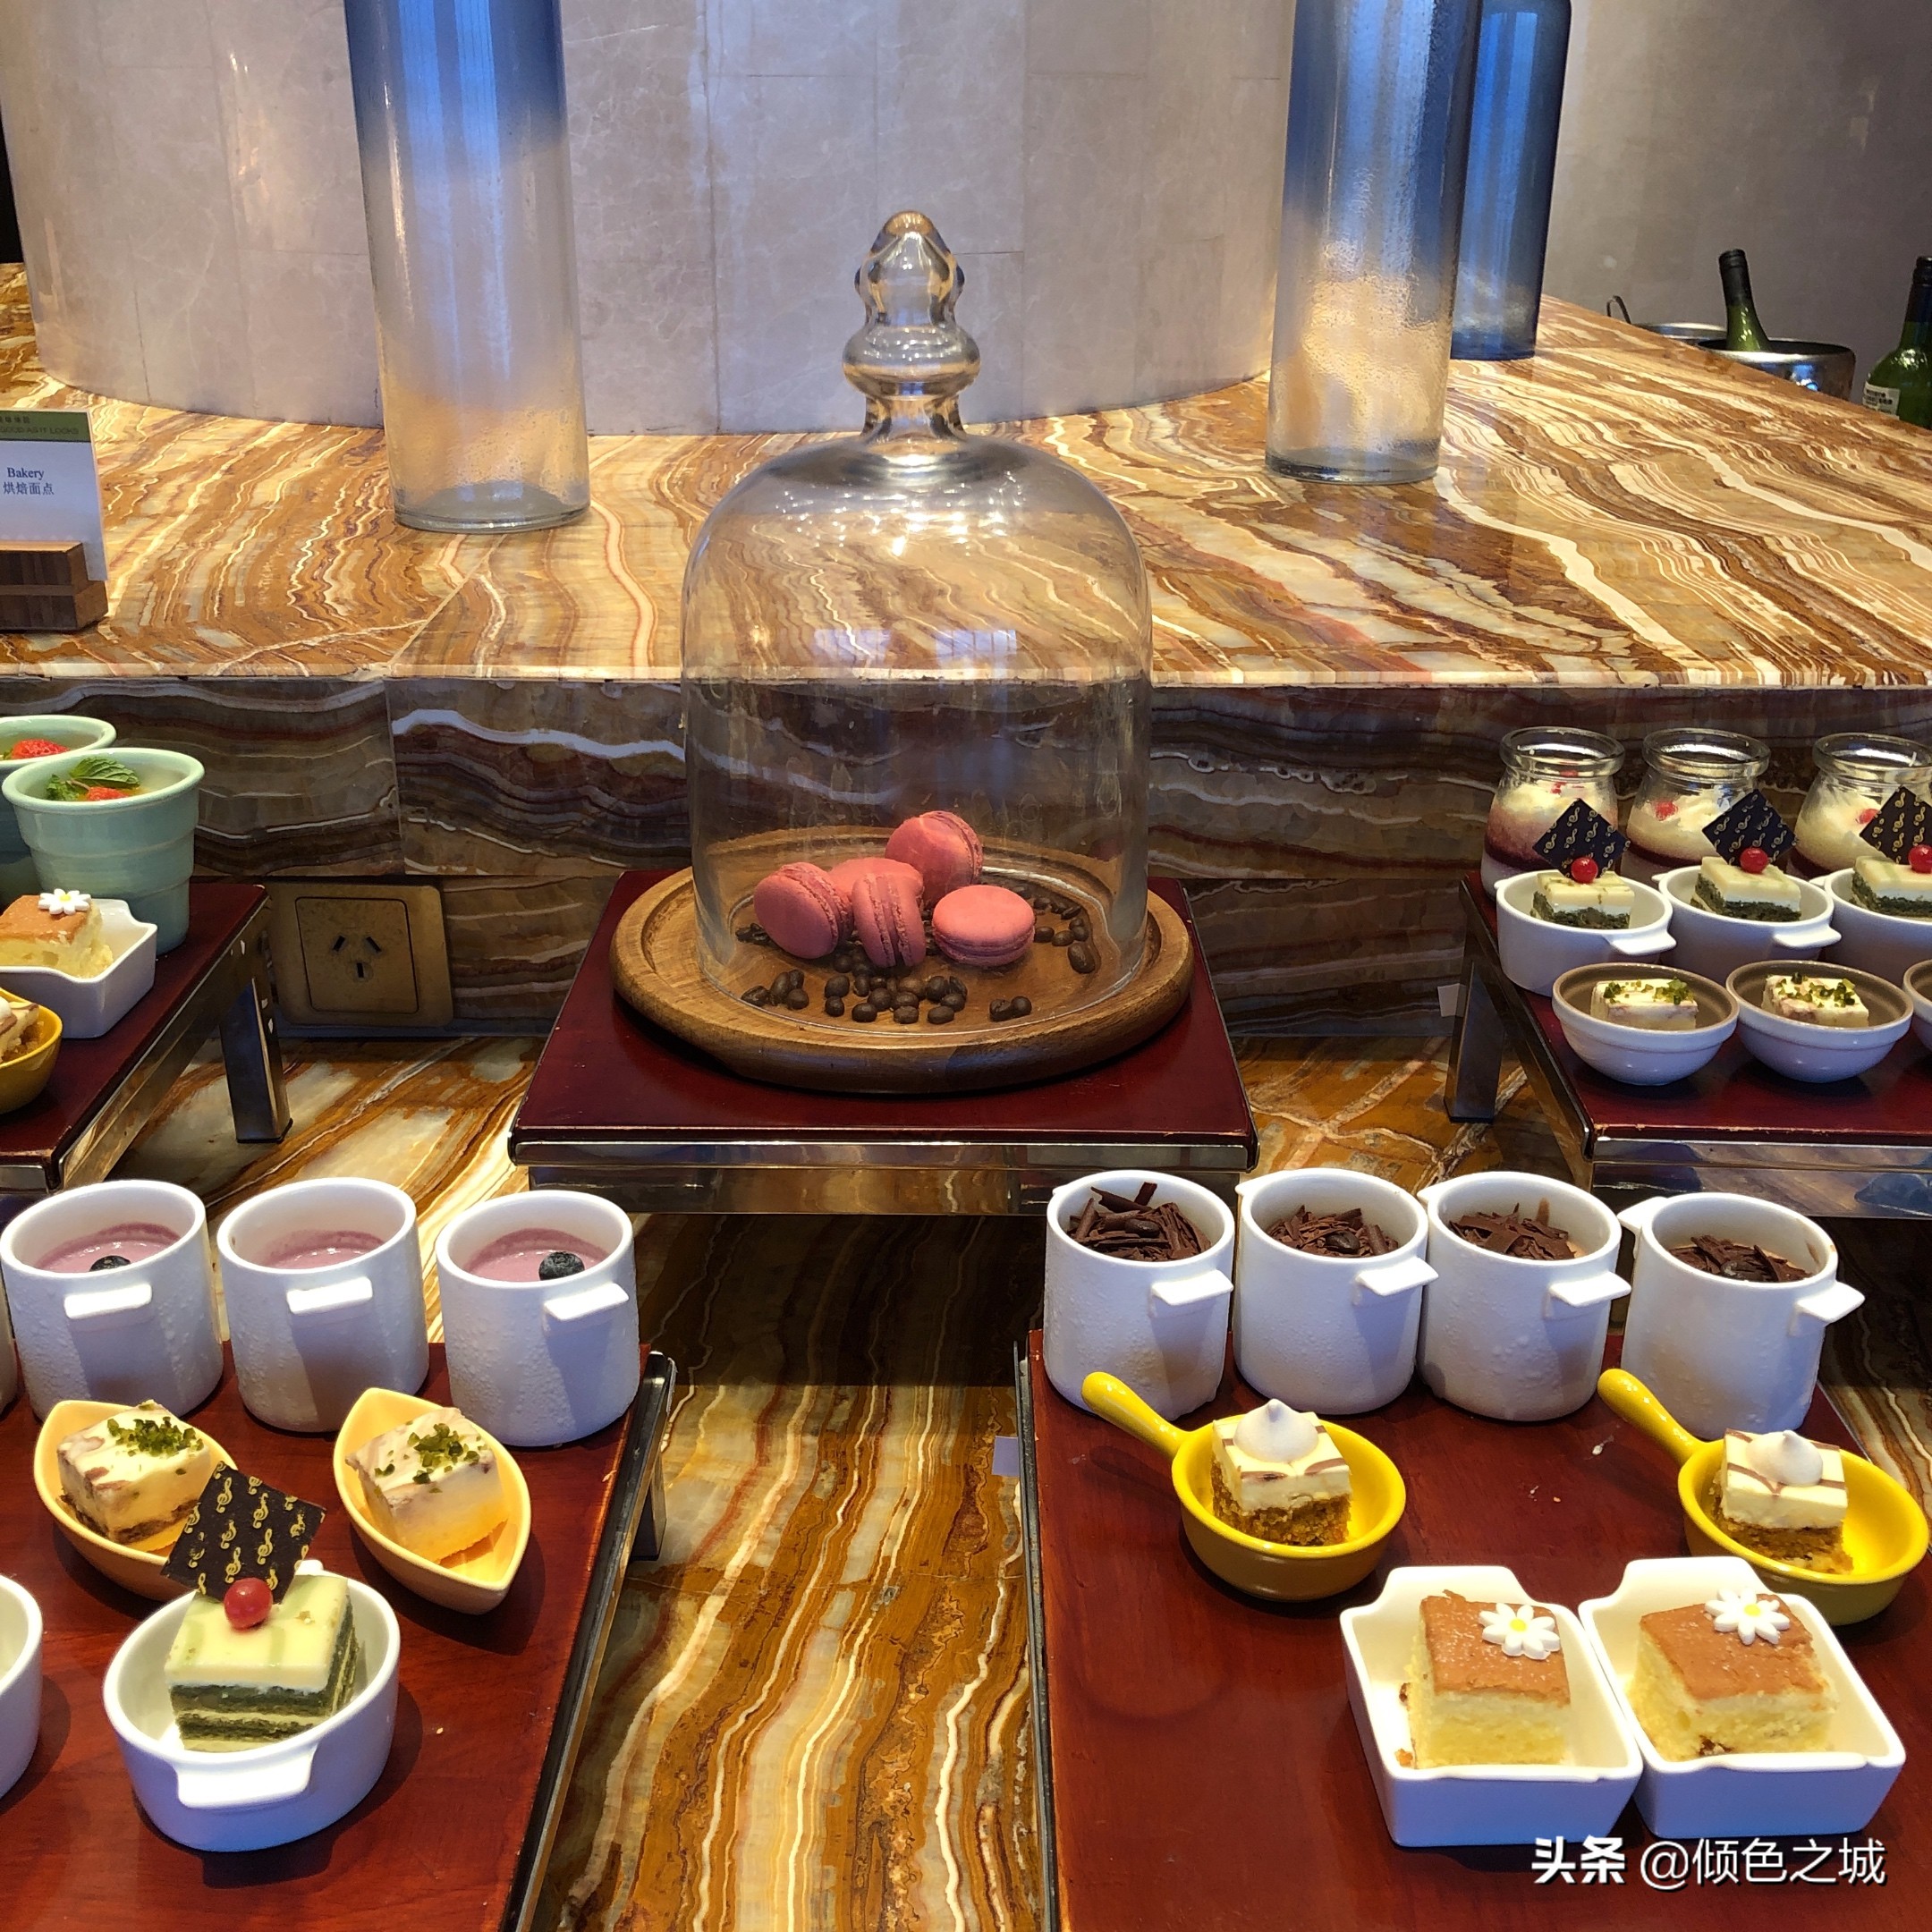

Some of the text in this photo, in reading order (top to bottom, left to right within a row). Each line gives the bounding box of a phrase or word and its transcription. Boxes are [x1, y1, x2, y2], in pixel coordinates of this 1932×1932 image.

[7, 467, 45, 481] Bakery
[3, 482, 55, 496] 烘焙面点
